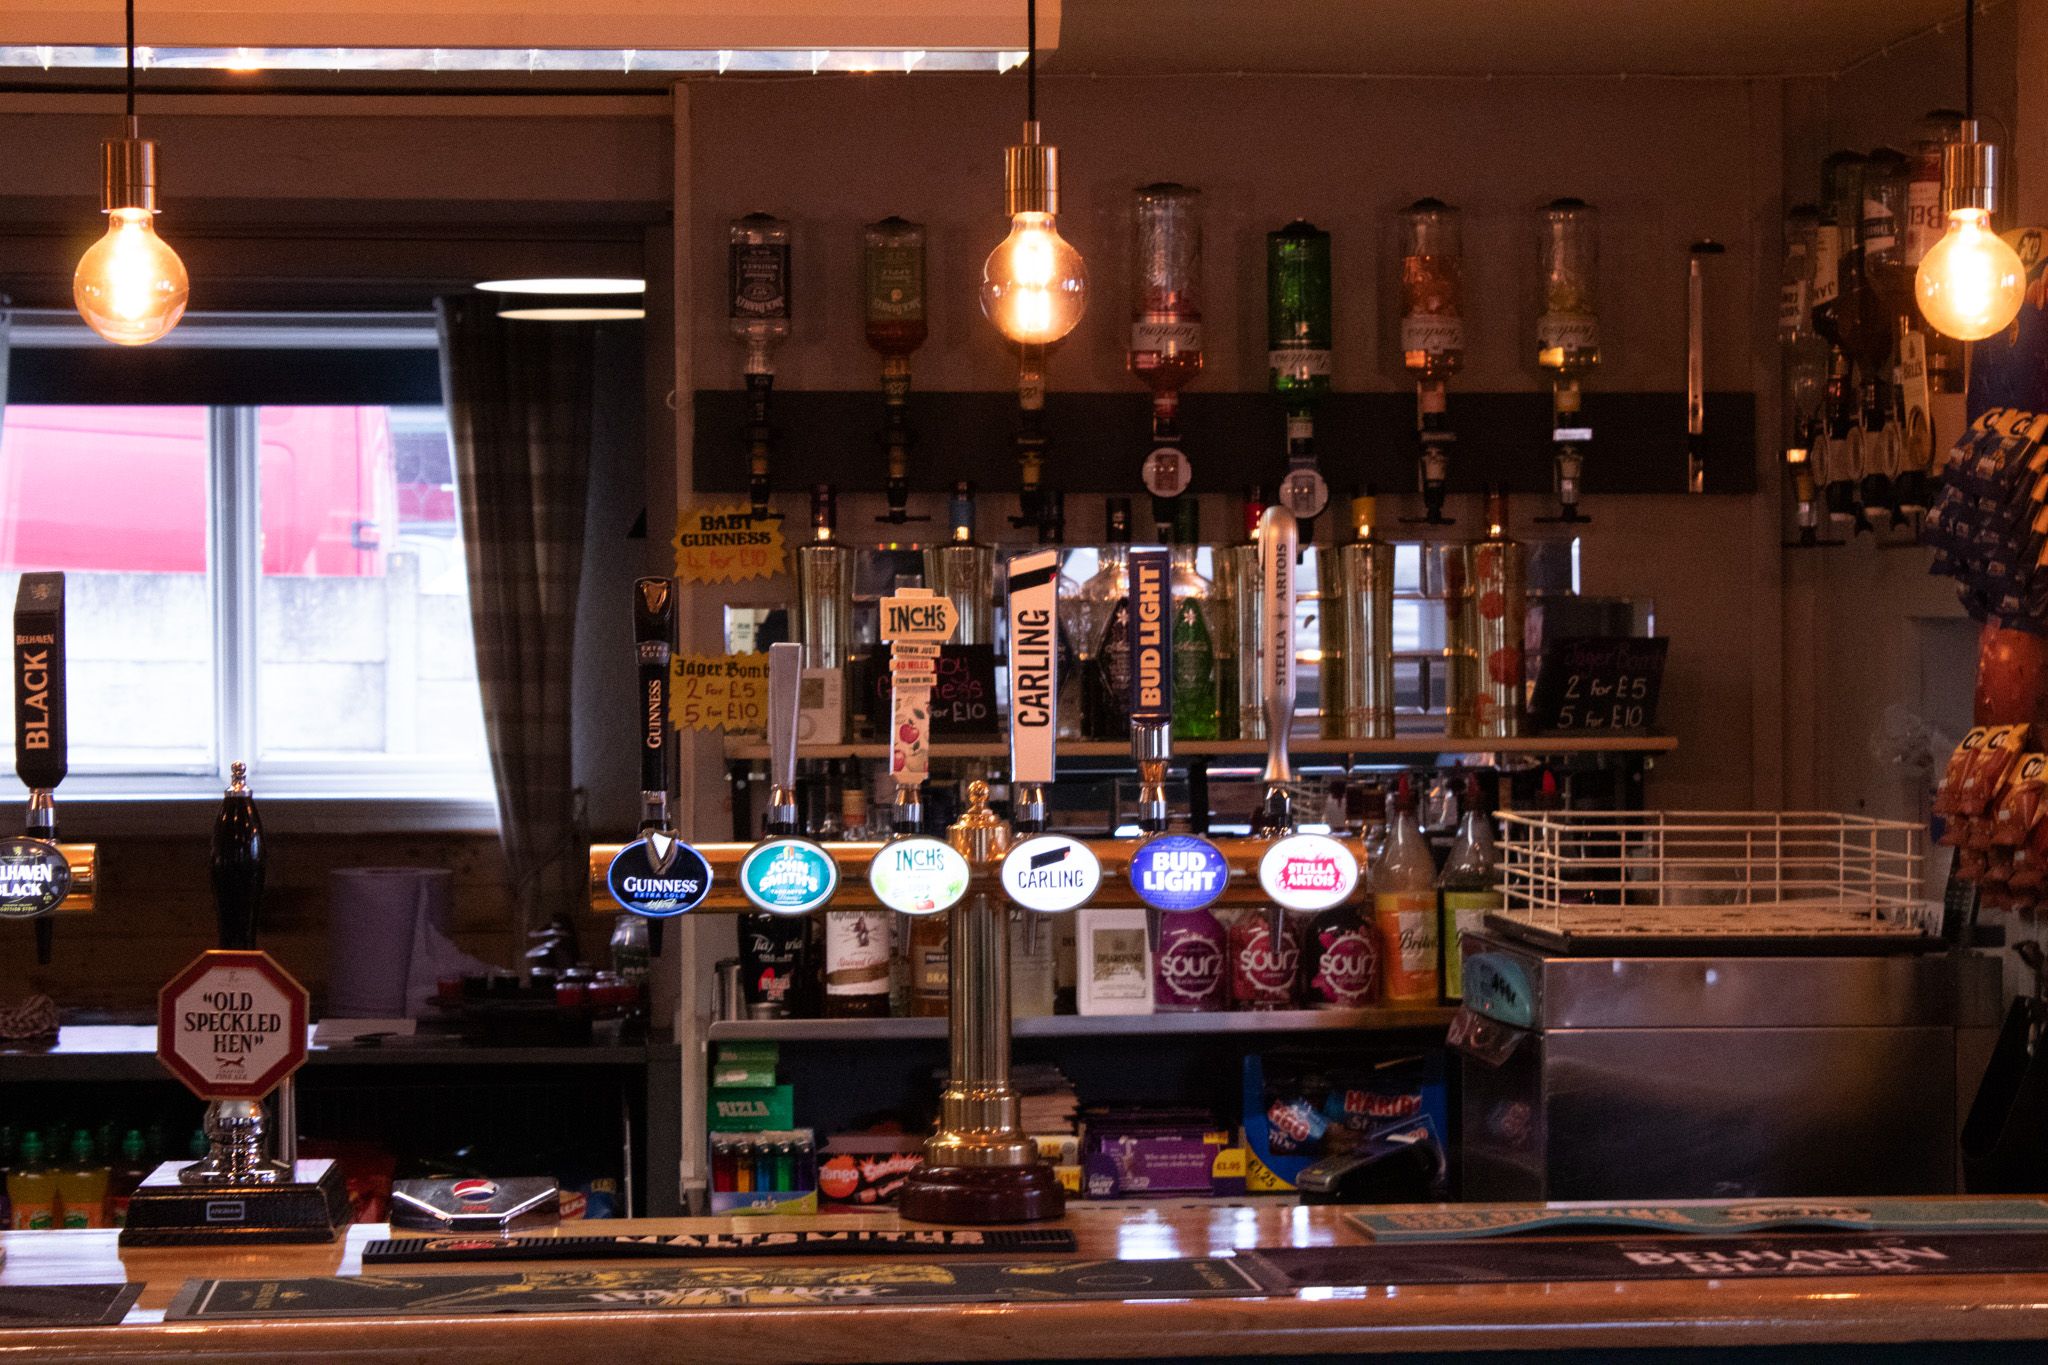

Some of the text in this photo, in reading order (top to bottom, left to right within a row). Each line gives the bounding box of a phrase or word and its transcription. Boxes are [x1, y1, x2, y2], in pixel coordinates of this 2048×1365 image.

[680, 532, 771, 547] GUINNESS
[1275, 543, 1287, 601] ARTOIS
[888, 604, 946, 633] INCH'S
[16, 634, 55, 645] BELHAVEN
[1139, 564, 1161, 707] BUD LIGHT
[1018, 609, 1050, 728] CARLING
[1275, 630, 1287, 686] STELLA
[686, 678, 702, 699] 2
[705, 682, 724, 696] for
[1565, 674, 1648, 699] 2 for £5
[24, 649, 49, 750] BLACK
[647, 679, 662, 749] GUINNESS
[685, 703, 700, 723] 5
[727, 702, 759, 720] £10
[952, 700, 987, 723] £10
[1556, 705, 1576, 729] 5
[1610, 704, 1644, 729] £10
[767, 858, 809, 875] JOHN
[895, 848, 945, 871] INCH'S
[1152, 851, 1207, 872] BUD
[1287, 862, 1335, 875] STELLA
[623, 876, 699, 894] GUINNESS
[1017, 869, 1085, 889] CARLING
[1142, 871, 1217, 893] LIGHT
[1286, 874, 1336, 888] ARTOIS
[1160, 953, 1224, 977] sourz
[1240, 949, 1300, 972] sourz
[1319, 951, 1376, 976] sourz
[184, 1012, 281, 1033] SPECKLED
[715, 1100, 770, 1118] RIZLA
[818, 1165, 860, 1183] Tango
[614, 1230, 985, 1248] MALTSMITHS
[1622, 1245, 1949, 1265] BELHAVEN
[1684, 1258, 1924, 1273] BLACK
